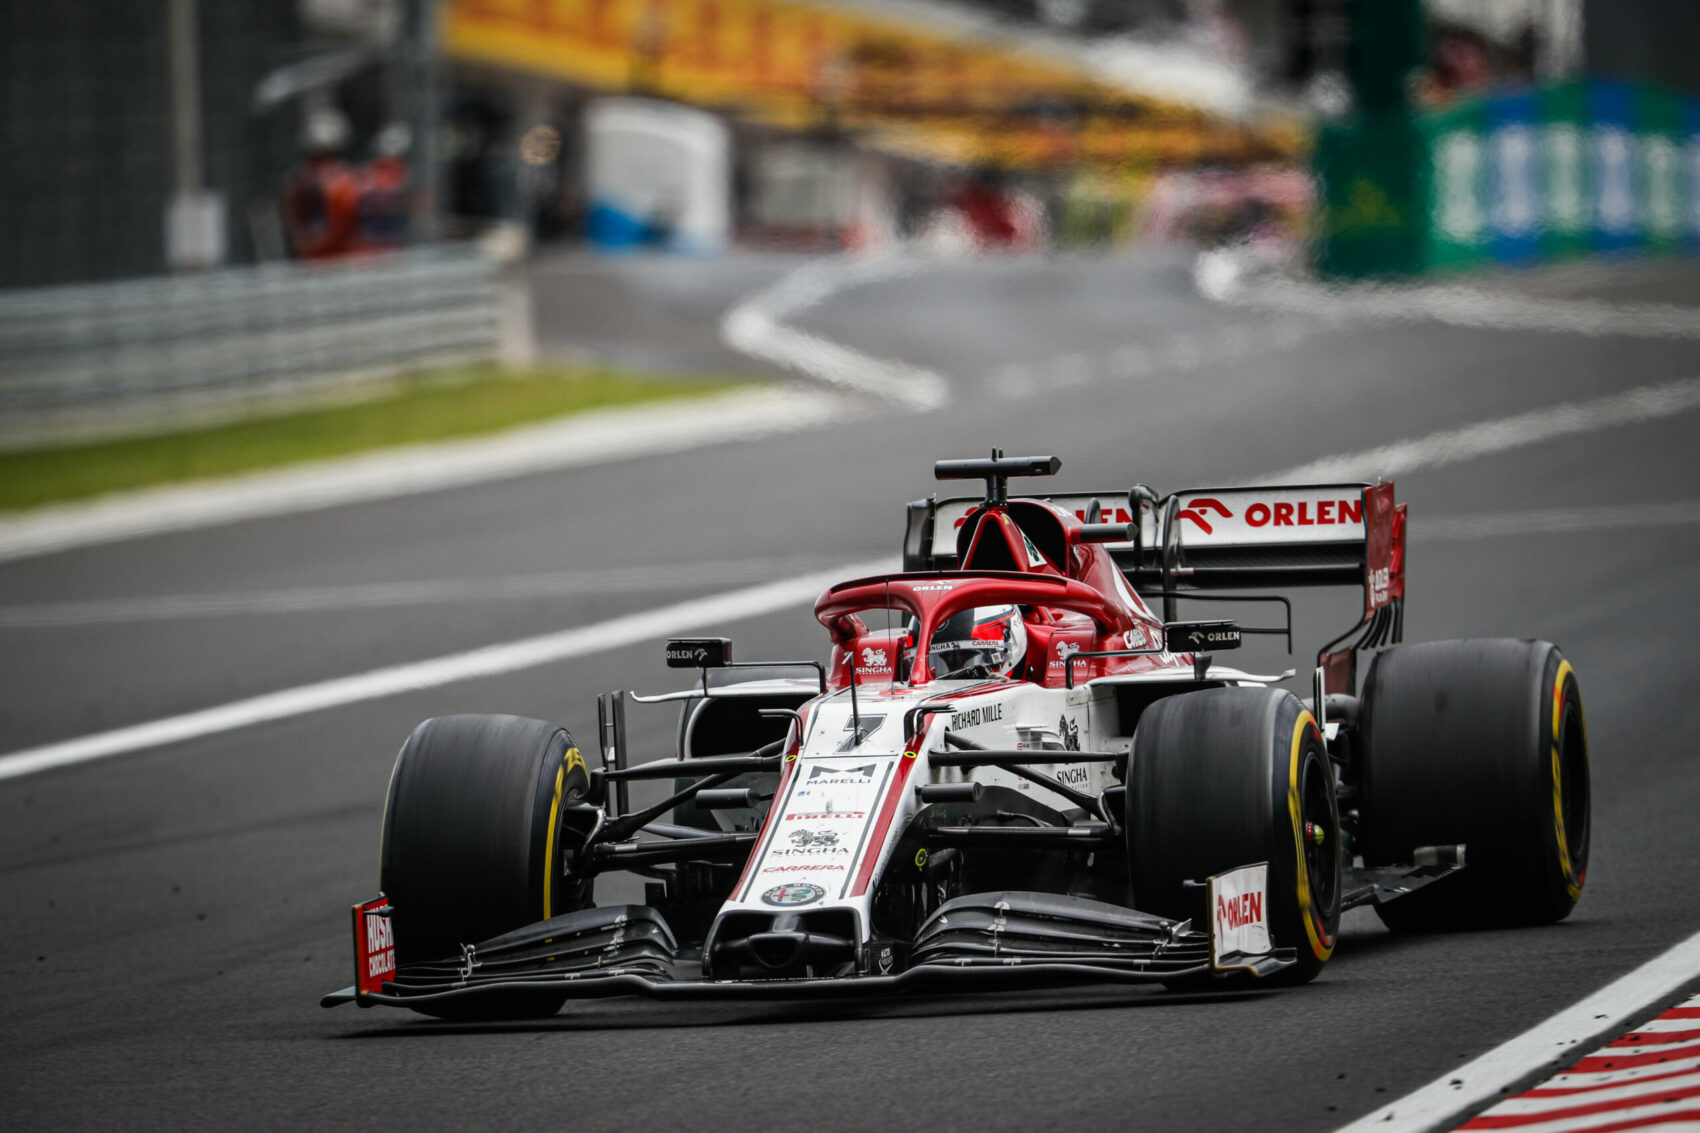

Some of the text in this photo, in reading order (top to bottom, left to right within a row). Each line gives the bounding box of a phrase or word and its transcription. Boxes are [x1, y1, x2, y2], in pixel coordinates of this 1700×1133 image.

[1245, 499, 1363, 528] ORLEN
[1207, 631, 1241, 642] ORLEN
[666, 649, 693, 659] ORLEN
[1049, 660, 1088, 668] SINHA
[855, 666, 893, 674] SINGHA
[951, 703, 1003, 732] RICHARD MILLE
[832, 712, 888, 755] 7
[1056, 767, 1088, 785] SINGHA
[772, 847, 849, 855] SINGHA
[763, 864, 845, 873] CARRERA
[1227, 891, 1262, 931] ORLEN
